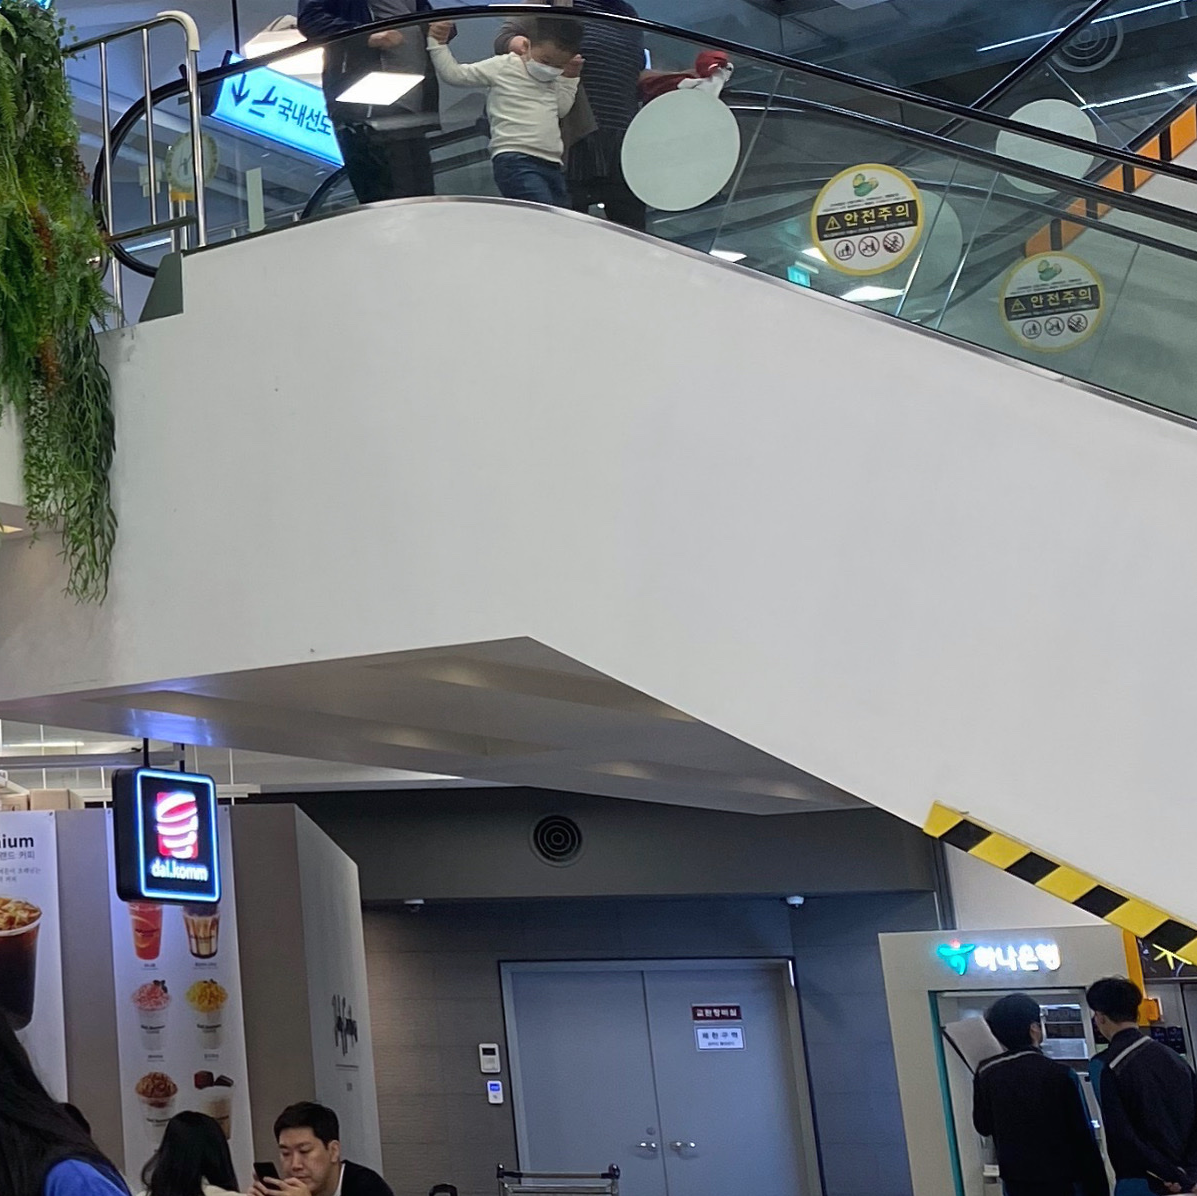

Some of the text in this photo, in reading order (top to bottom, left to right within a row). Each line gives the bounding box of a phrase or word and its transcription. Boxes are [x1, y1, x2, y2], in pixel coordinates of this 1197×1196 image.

[843, 203, 910, 227] 안전주의
[1030, 287, 1092, 309] 안전주의
[19, 850, 35, 860] 커피
